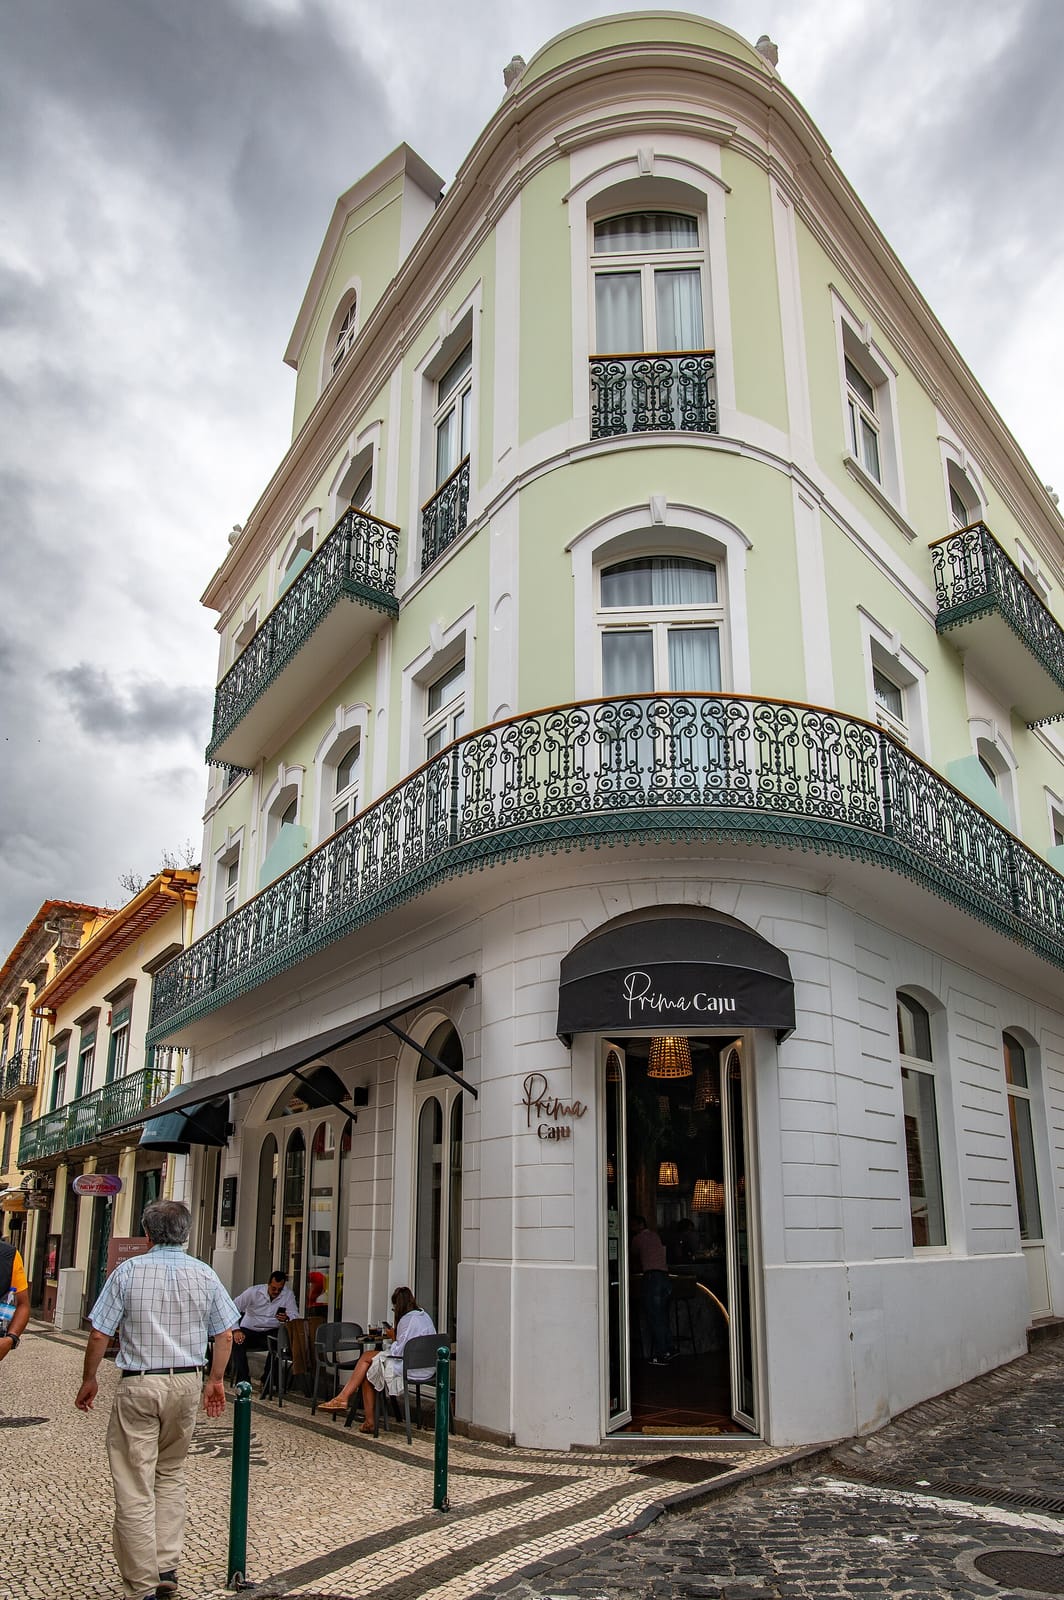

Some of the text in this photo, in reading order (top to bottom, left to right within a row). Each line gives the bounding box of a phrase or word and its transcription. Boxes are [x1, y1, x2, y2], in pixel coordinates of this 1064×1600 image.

[622, 971, 736, 1020] Prima Caju
[522, 1072, 588, 1128] Prima
[536, 1122, 571, 1142] Caju
